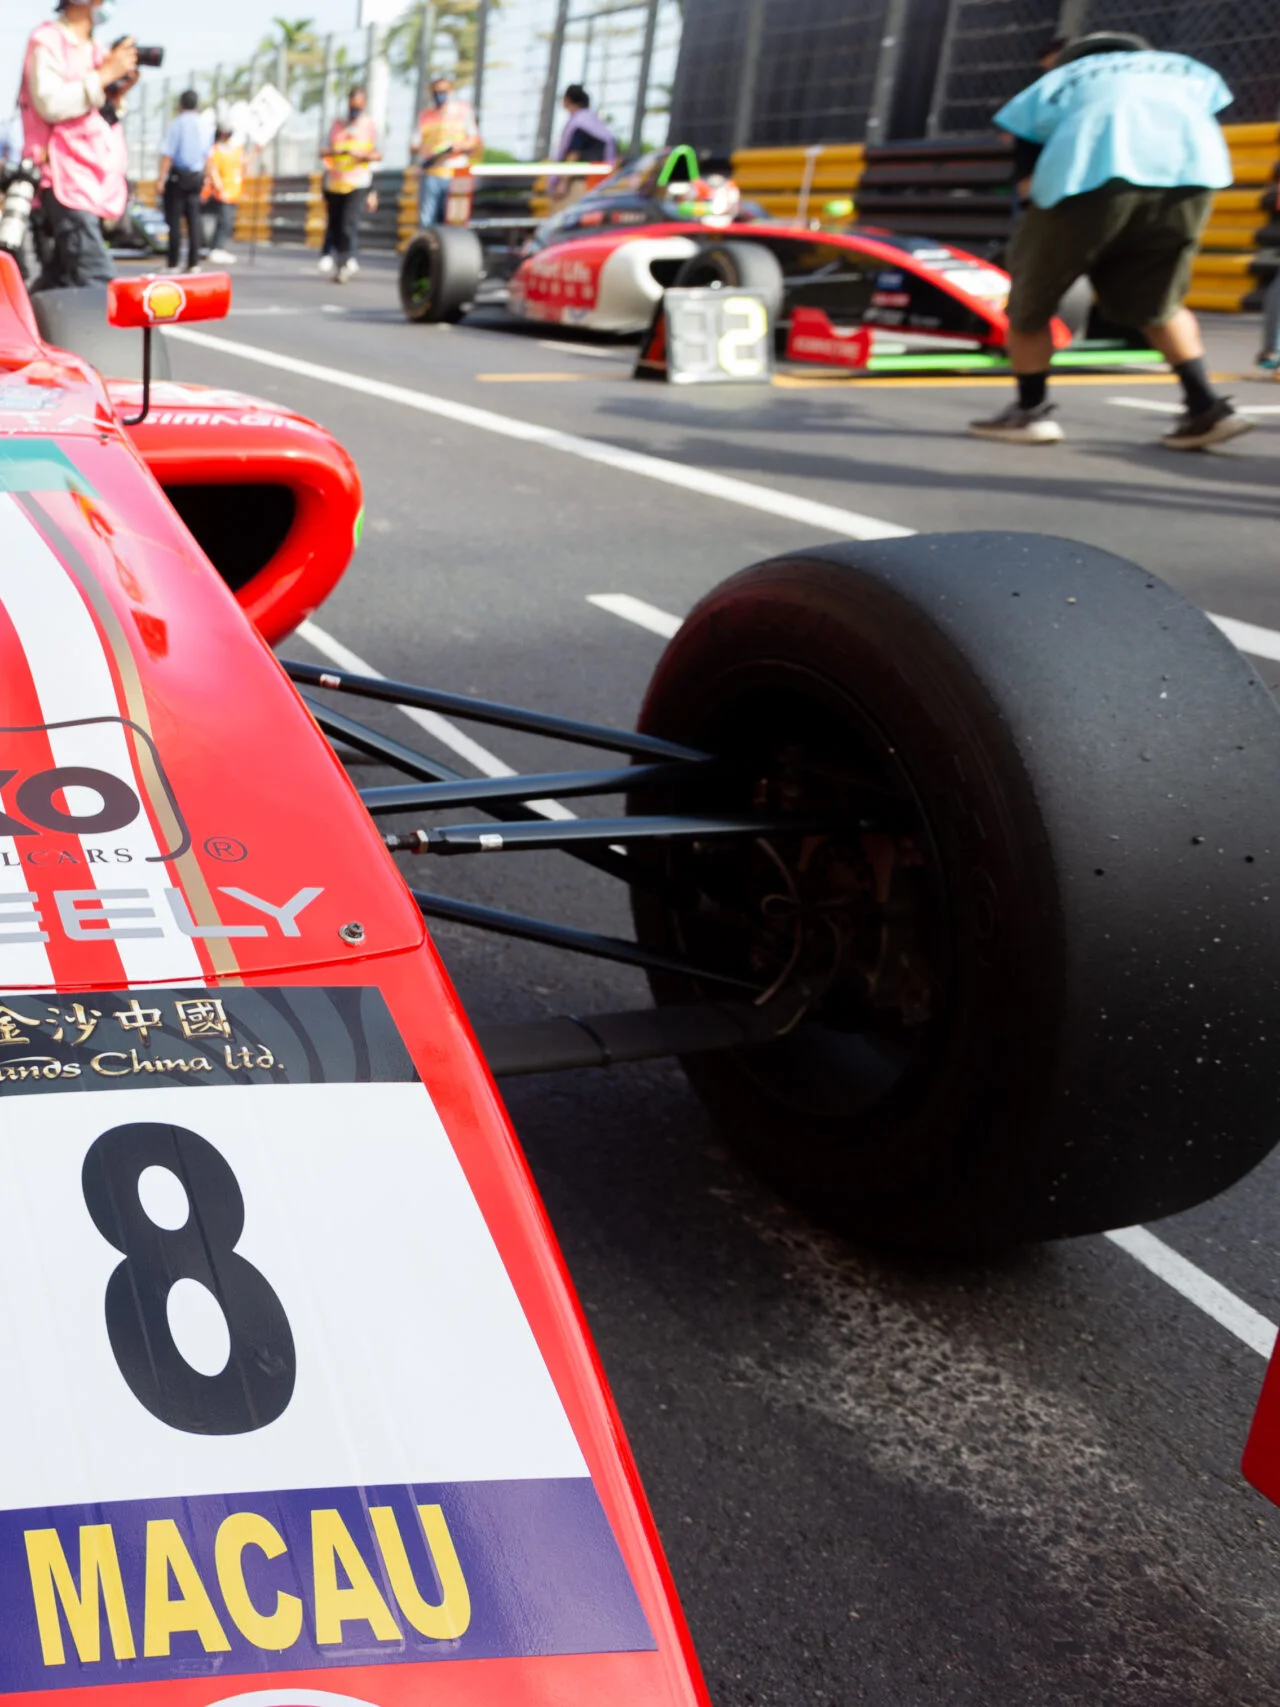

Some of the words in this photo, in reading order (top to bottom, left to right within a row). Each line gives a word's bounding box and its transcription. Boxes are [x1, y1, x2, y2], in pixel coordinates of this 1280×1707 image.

[718, 297, 767, 377] 2
[90, 1049, 213, 1076] China
[82, 1122, 297, 1435] 8
[24, 1504, 471, 1665] MACAU
